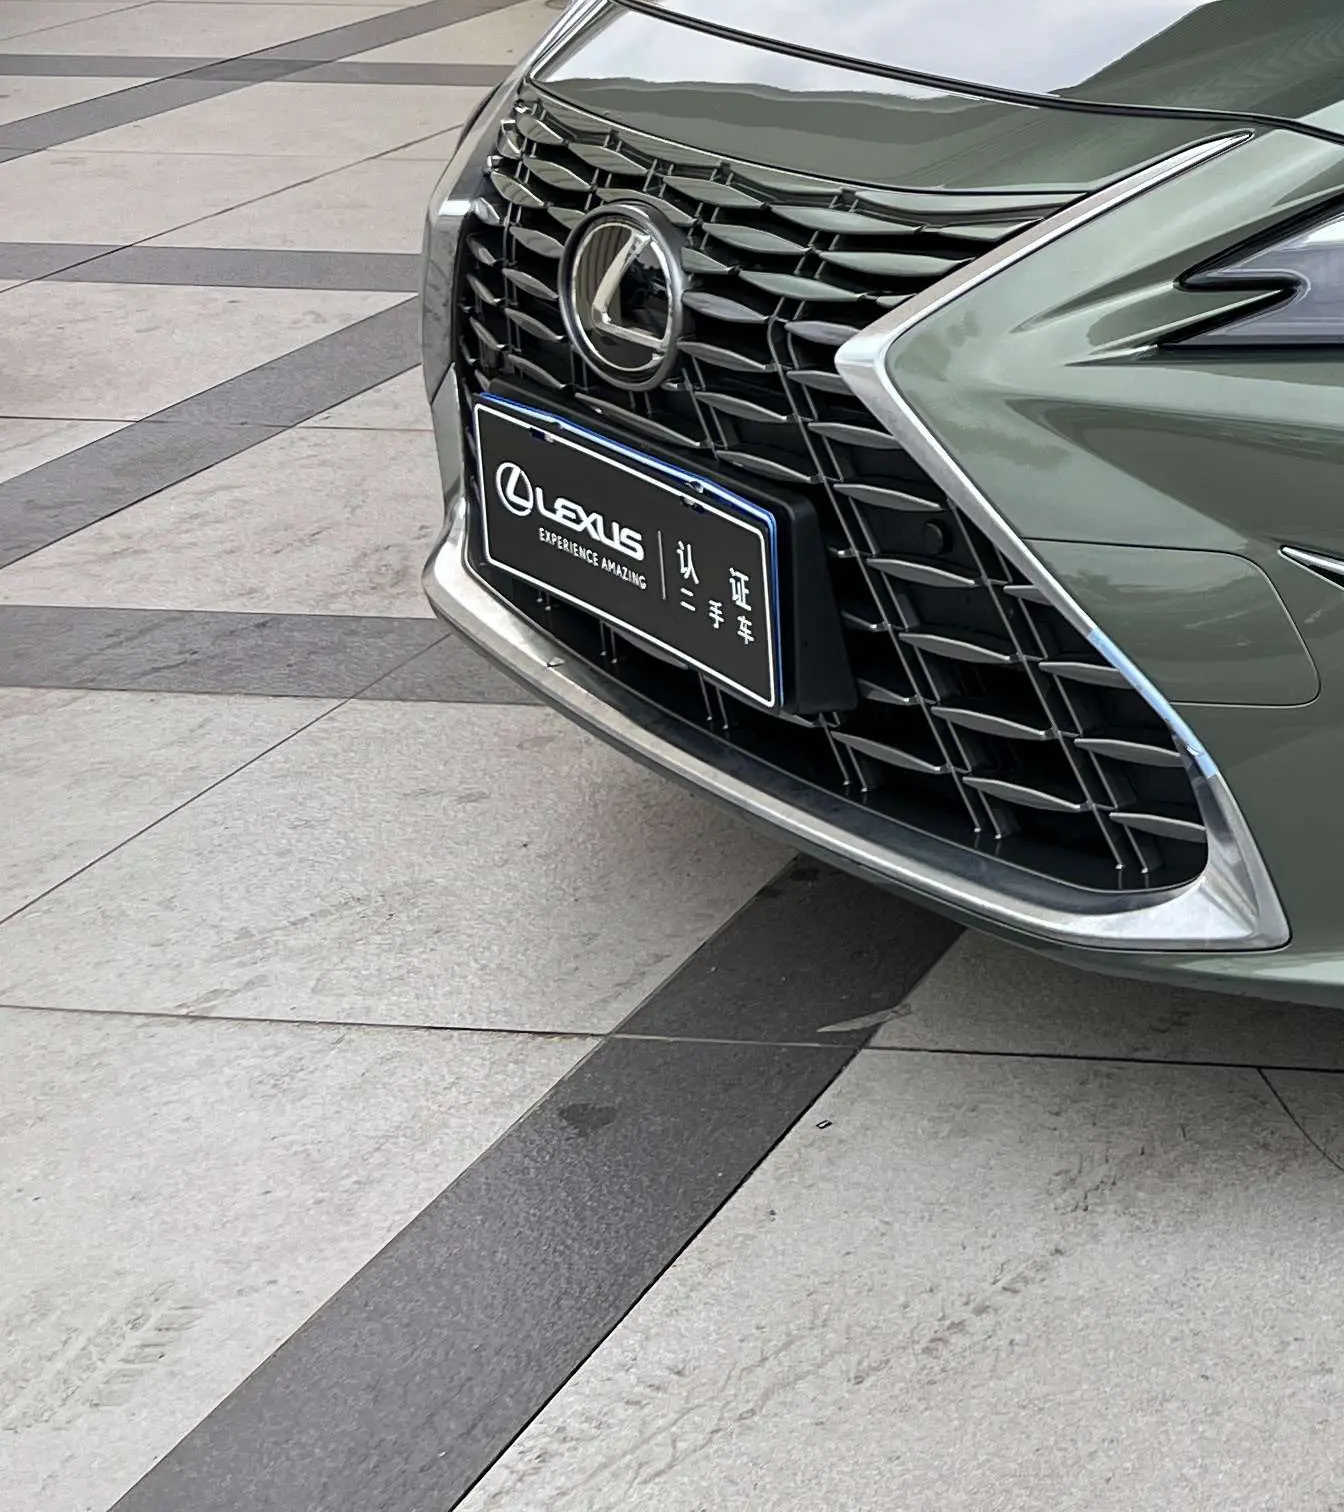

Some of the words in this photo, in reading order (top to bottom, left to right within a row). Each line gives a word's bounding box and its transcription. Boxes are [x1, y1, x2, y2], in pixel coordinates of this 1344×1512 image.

[535, 487, 645, 561] LEXUS
[538, 527, 599, 567] EXPERIENCE
[601, 556, 647, 590] AMAZING
[676, 541, 752, 611] 认证
[680, 587, 755, 645] 二手车
